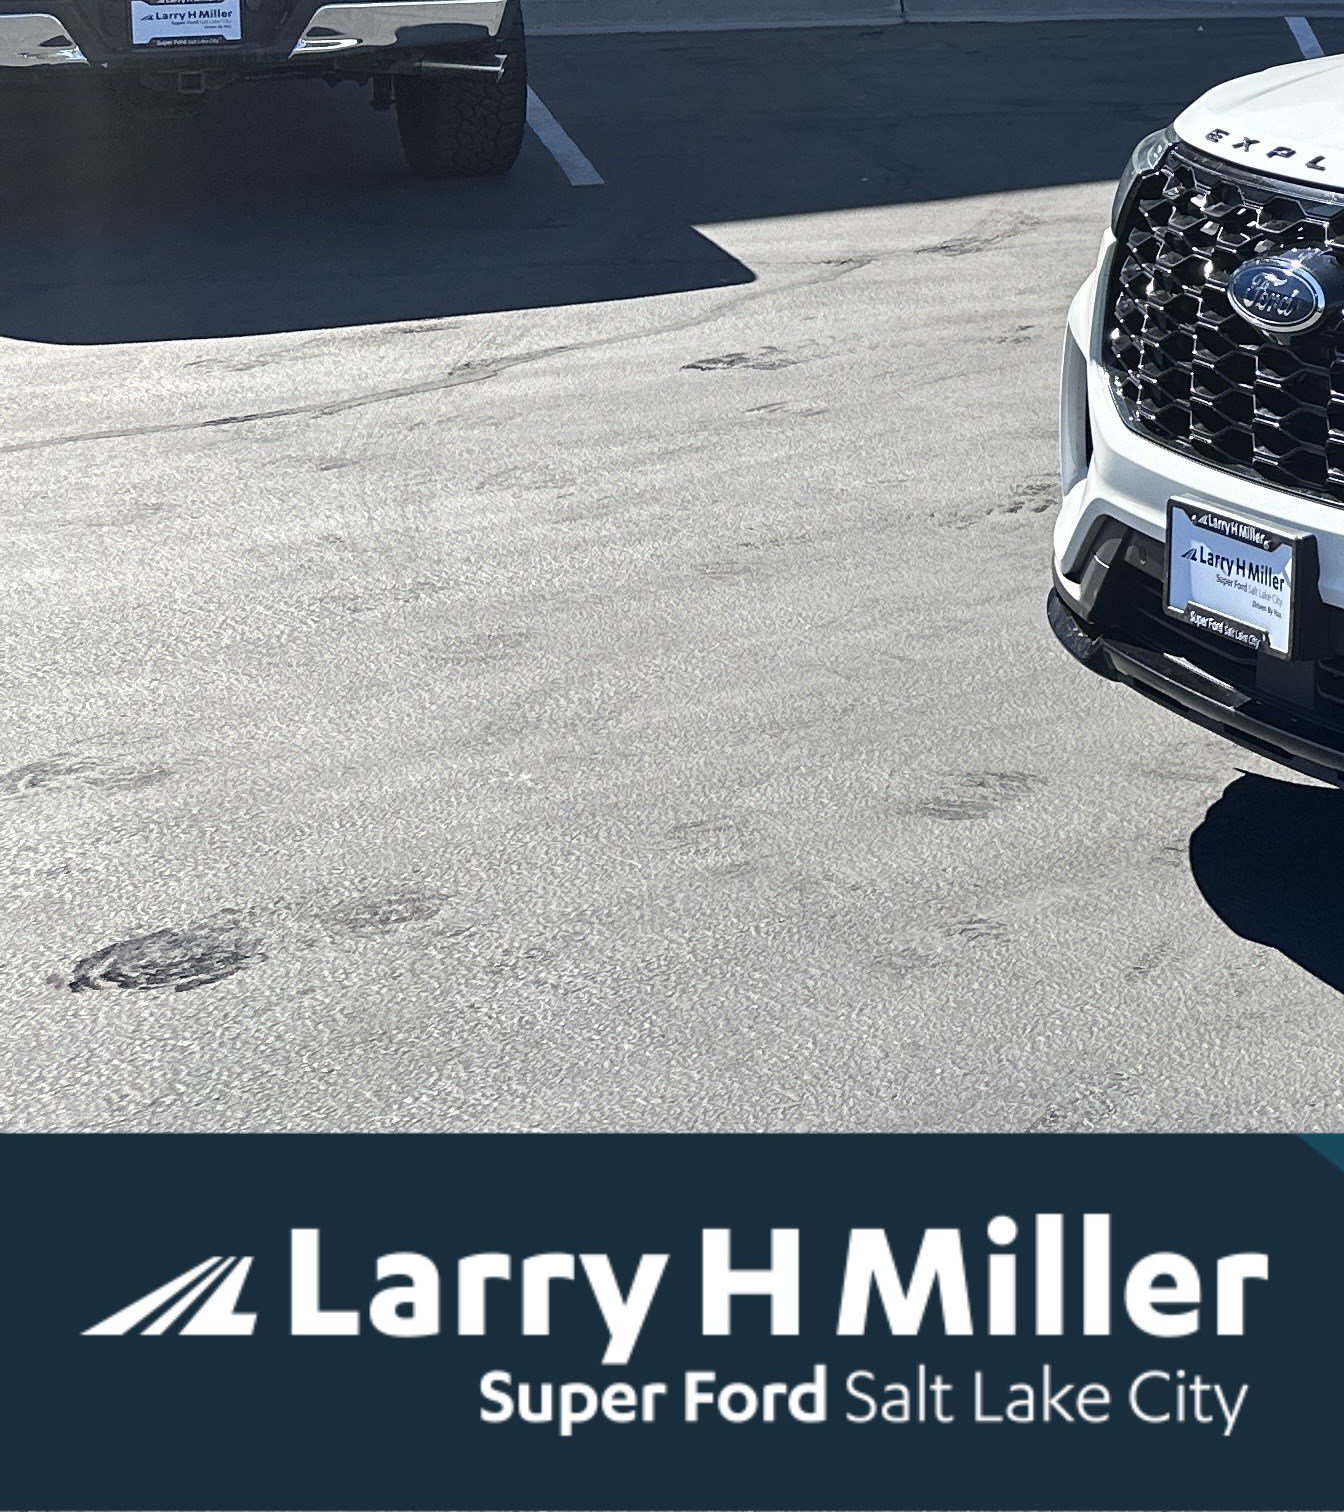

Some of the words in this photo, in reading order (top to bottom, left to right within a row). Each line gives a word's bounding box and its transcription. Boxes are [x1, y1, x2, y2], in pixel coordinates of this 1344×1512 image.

[156, 11, 186, 21] Larry
[188, 10, 196, 19] H
[199, 9, 233, 19] Miller
[1244, 271, 1300, 316] Ford
[1208, 514, 1230, 535] Larry
[1231, 522, 1238, 535] H
[1238, 524, 1265, 544] Miller
[1199, 545, 1234, 577] Larry
[1236, 558, 1245, 578] H
[1247, 564, 1285, 592] Miller
[1216, 574, 1233, 588] Super
